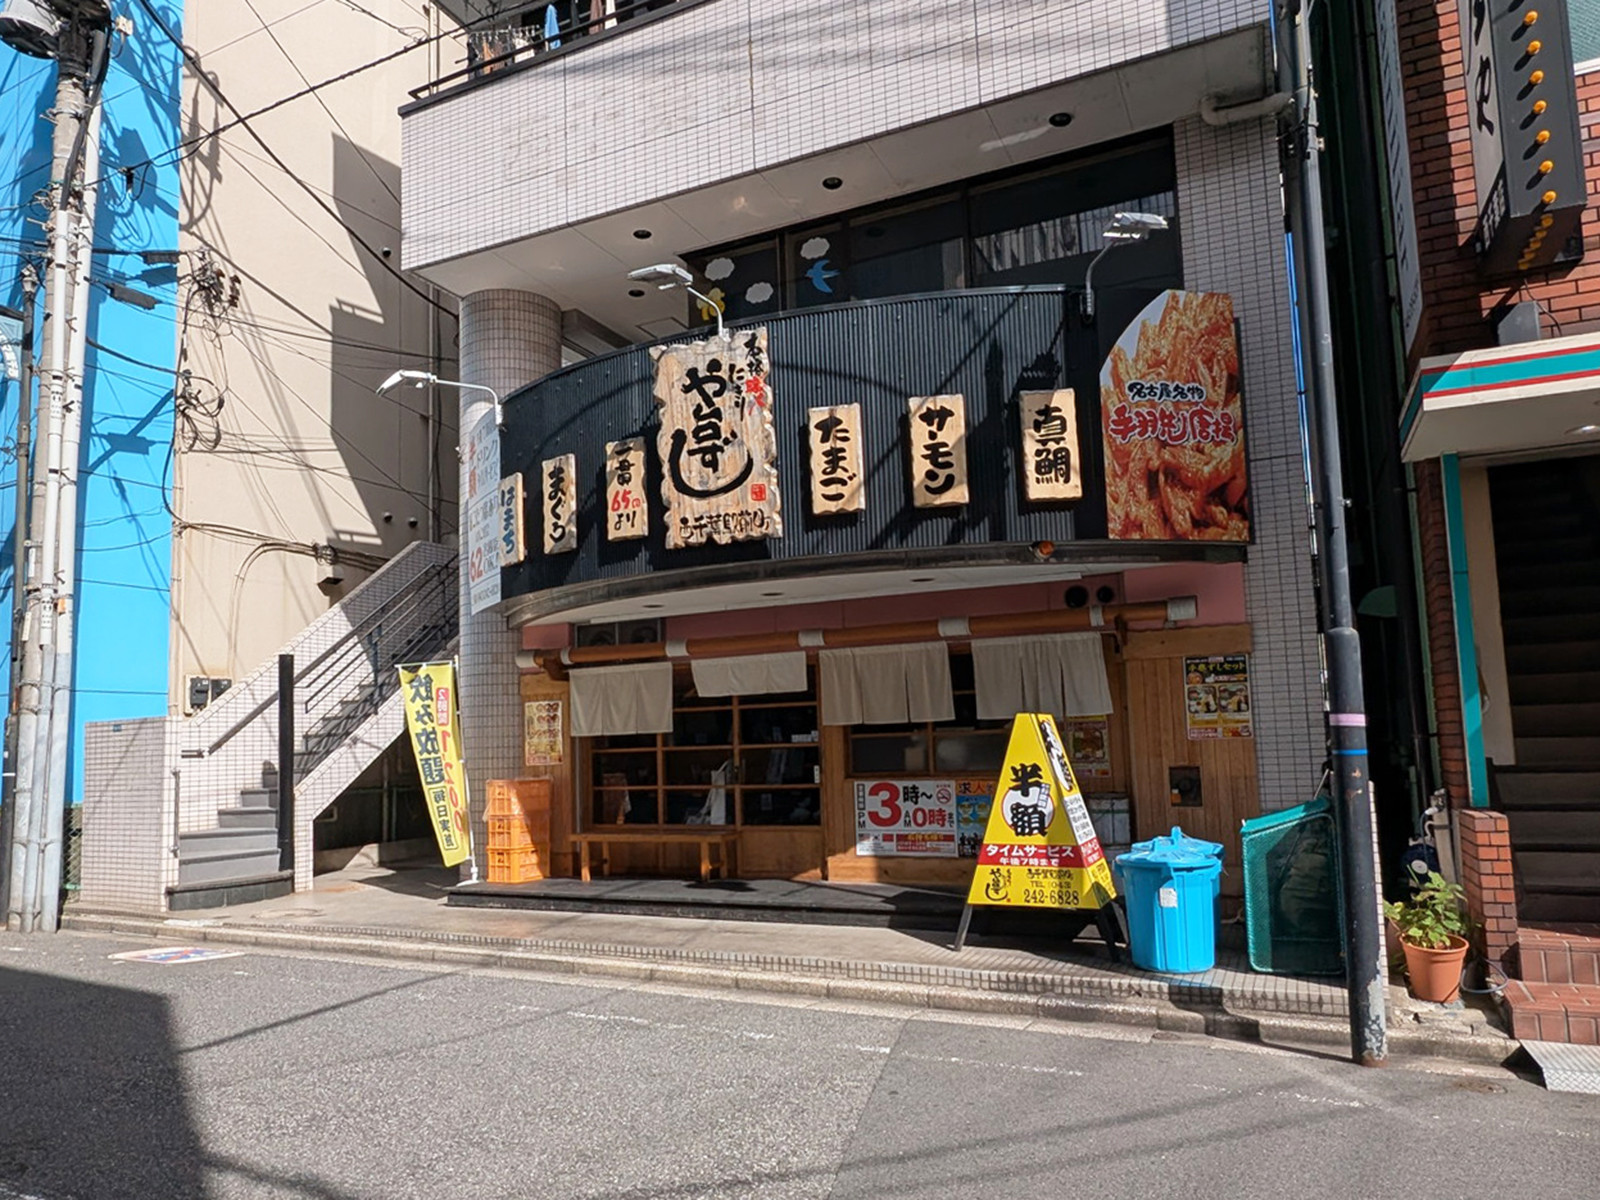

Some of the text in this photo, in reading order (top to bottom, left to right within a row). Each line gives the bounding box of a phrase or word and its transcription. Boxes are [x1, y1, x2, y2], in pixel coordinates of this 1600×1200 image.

[1127, 381, 1205, 401] 名古屋名物
[615, 447, 635, 486] 一貫
[814, 416, 857, 501] たまご
[919, 405, 955, 496] サーモン
[1033, 404, 1071, 485] 真鯛
[501, 486, 515, 554] はまち
[548, 466, 566, 543] まぐろ
[614, 510, 637, 531] より
[1009, 763, 1048, 837] 半額
[986, 844, 1075, 858] タイムサービス
[1023, 889, 1080, 905] 242-6828
